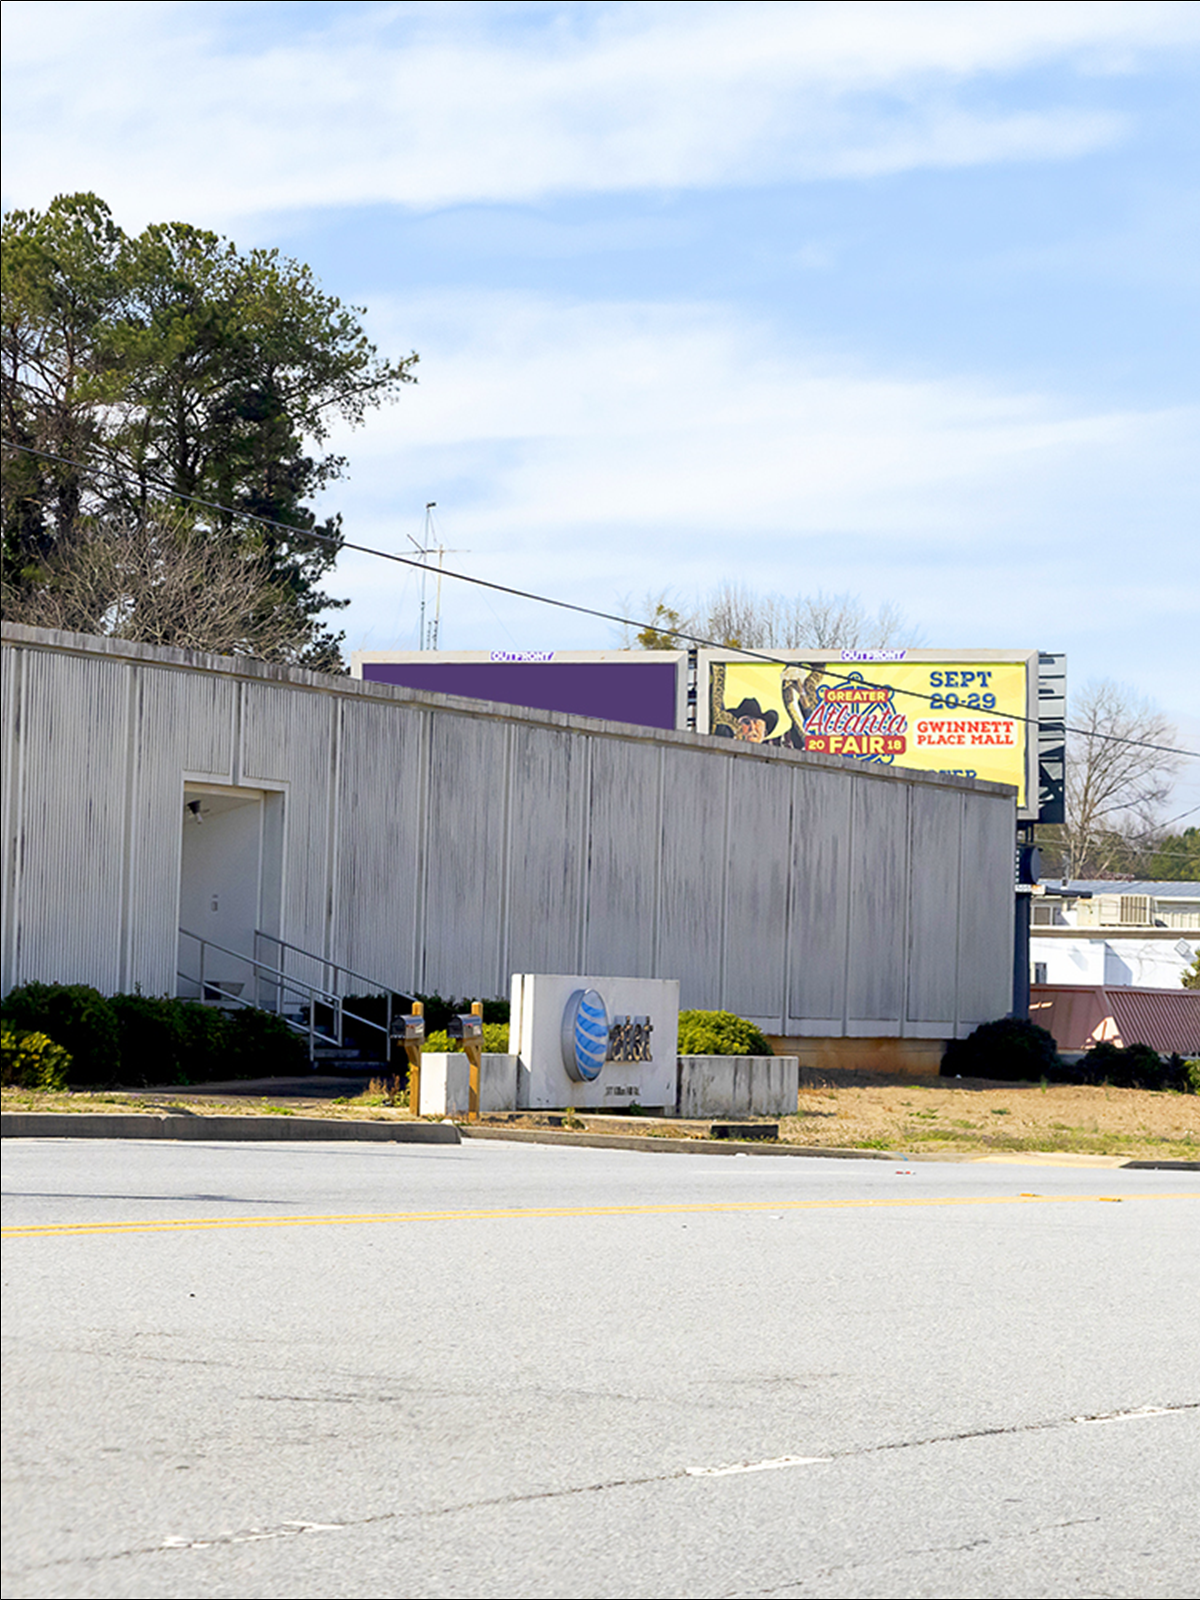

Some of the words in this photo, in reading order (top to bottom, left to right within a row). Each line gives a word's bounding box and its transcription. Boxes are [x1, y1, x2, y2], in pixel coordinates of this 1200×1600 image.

[930, 671, 992, 688] SEPT
[827, 691, 886, 701] GREATER
[930, 693, 996, 709] 20-29
[804, 703, 907, 733] Atlanta
[917, 721, 1014, 733] GWINNETT
[808, 739, 826, 750] 20
[829, 736, 886, 754] FAIR
[887, 740, 902, 750] 18
[917, 734, 966, 745] PLACE
[971, 734, 1014, 745] MALL
